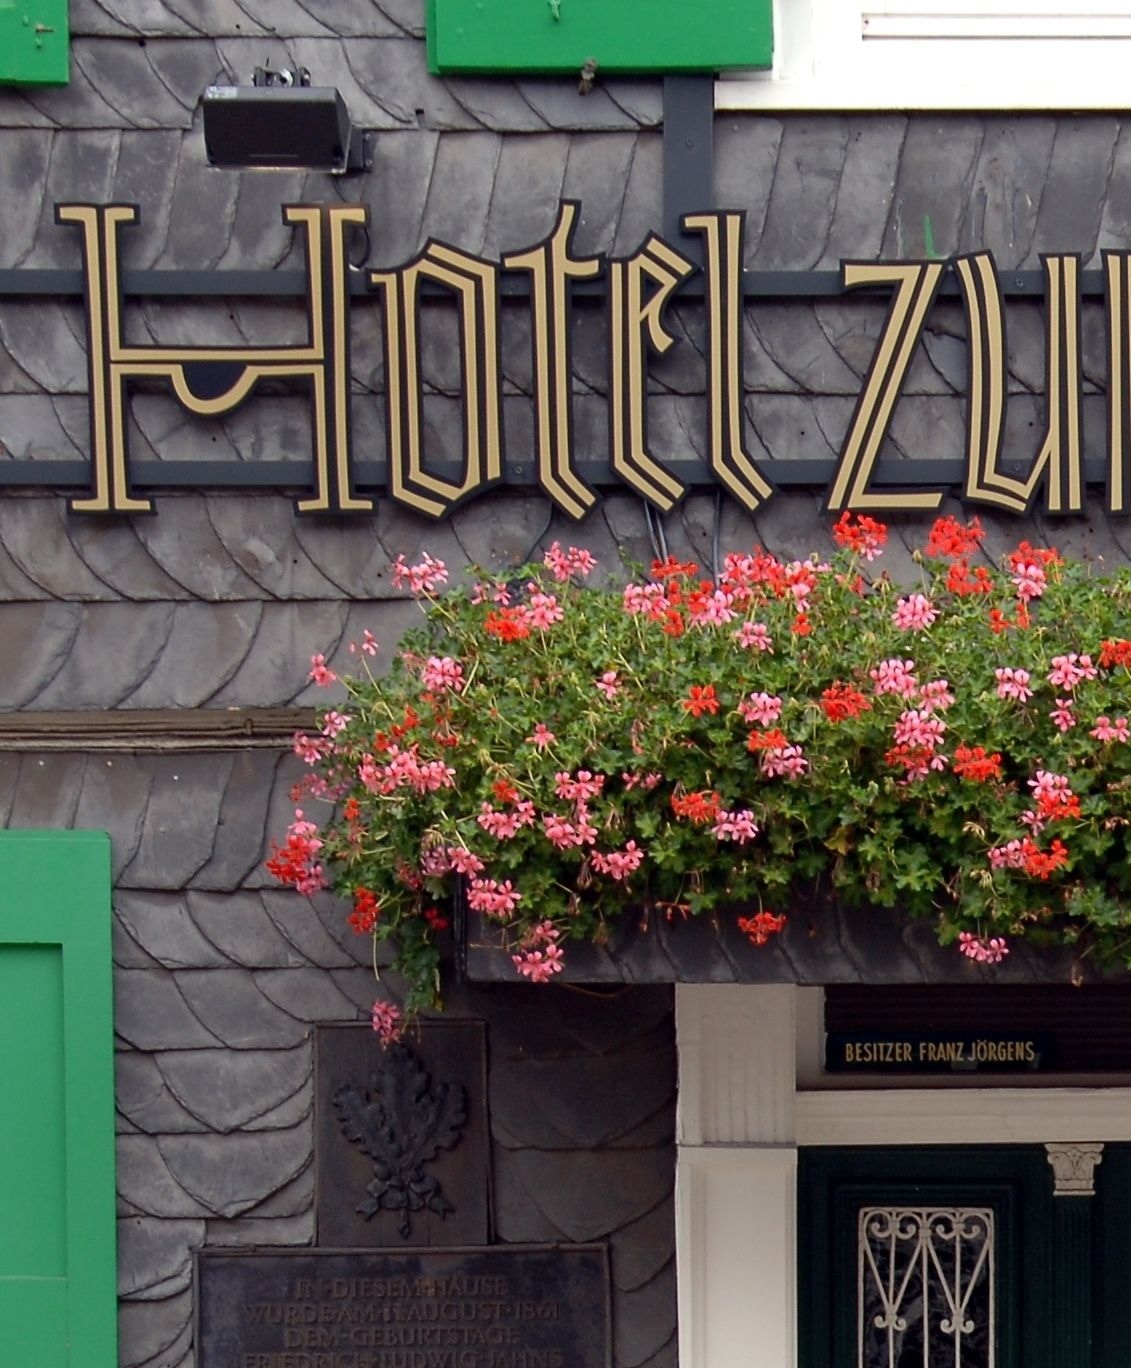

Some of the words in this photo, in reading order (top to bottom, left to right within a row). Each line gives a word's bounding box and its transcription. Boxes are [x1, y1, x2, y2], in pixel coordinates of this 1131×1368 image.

[52, 198, 779, 520] Hotel
[845, 1043, 912, 1062] BESITZER
[919, 1042, 964, 1062] FRANZ
[968, 1039, 1035, 1062] JÖRGENS
[333, 1276, 423, 1299] DIESEM
[430, 1275, 509, 1298] HAUSE
[241, 1304, 332, 1325] WURDE
[514, 1300, 560, 1320] 1861
[283, 1328, 343, 1348] DEM
[351, 1326, 521, 1347] GEBURTSTAGE
